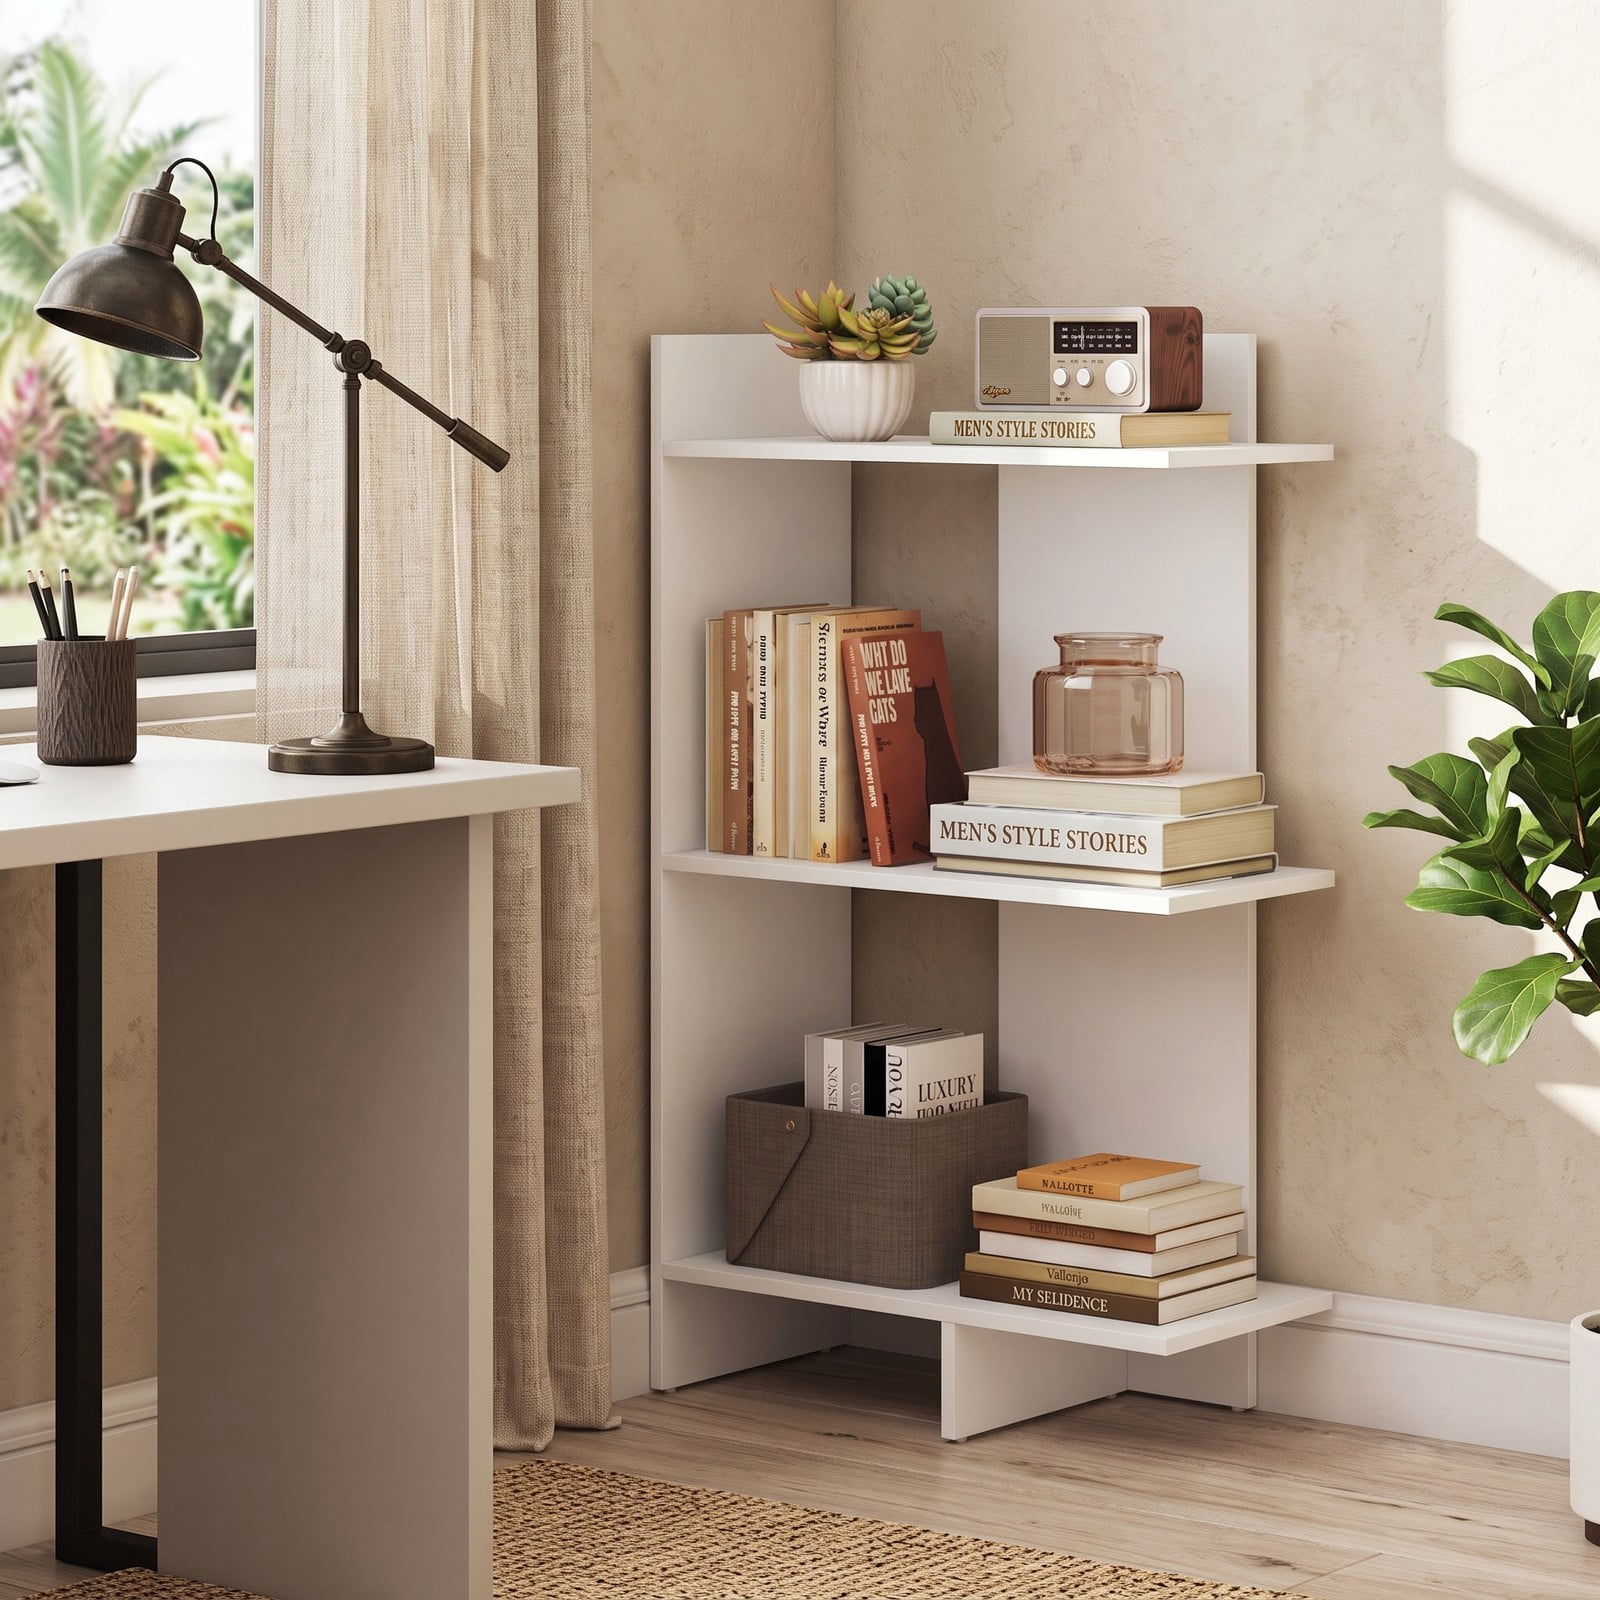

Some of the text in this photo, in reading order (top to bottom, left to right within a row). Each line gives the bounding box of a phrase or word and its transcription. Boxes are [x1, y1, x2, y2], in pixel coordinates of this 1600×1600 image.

[954, 419, 1096, 439] MEN'S STYLE STORIES
[859, 639, 907, 669] WHT DO
[864, 670, 885, 696] WE
[868, 697, 897, 724] CATS
[940, 820, 1147, 855] MEN'S STYLE STORIES
[918, 1073, 977, 1103] LUXURY
[1041, 1178, 1094, 1196] NALLOTTE
[1012, 1286, 1108, 1313] MY SELIDENCE
